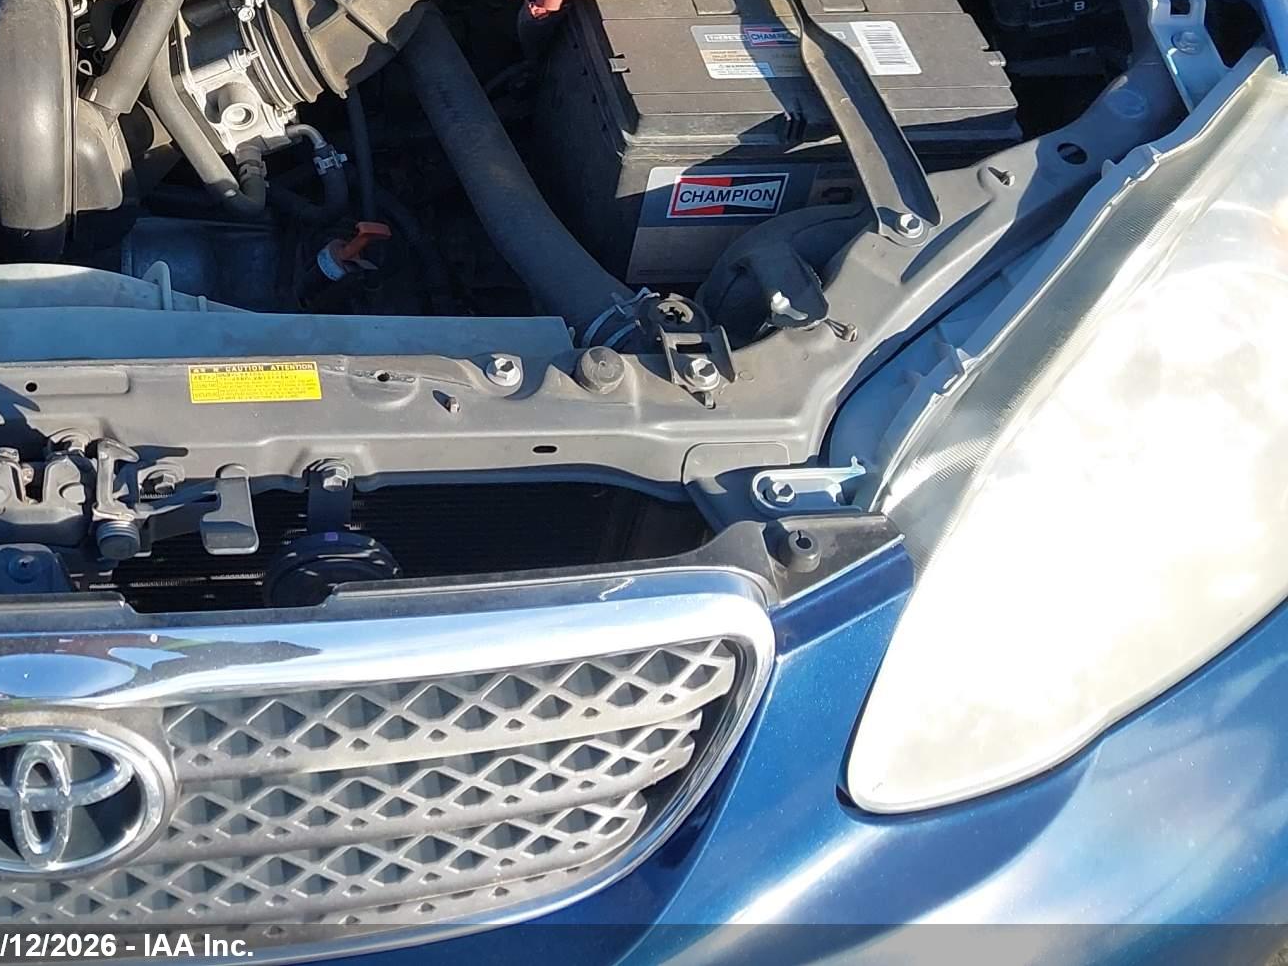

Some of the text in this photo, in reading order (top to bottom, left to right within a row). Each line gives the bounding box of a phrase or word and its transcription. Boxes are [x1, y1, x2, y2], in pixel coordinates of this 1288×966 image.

[751, 33, 799, 41] CHAMPIO
[679, 188, 776, 203] CHAMPION
[225, 364, 264, 372] CAUTION
[270, 363, 313, 371] ATTENTION
